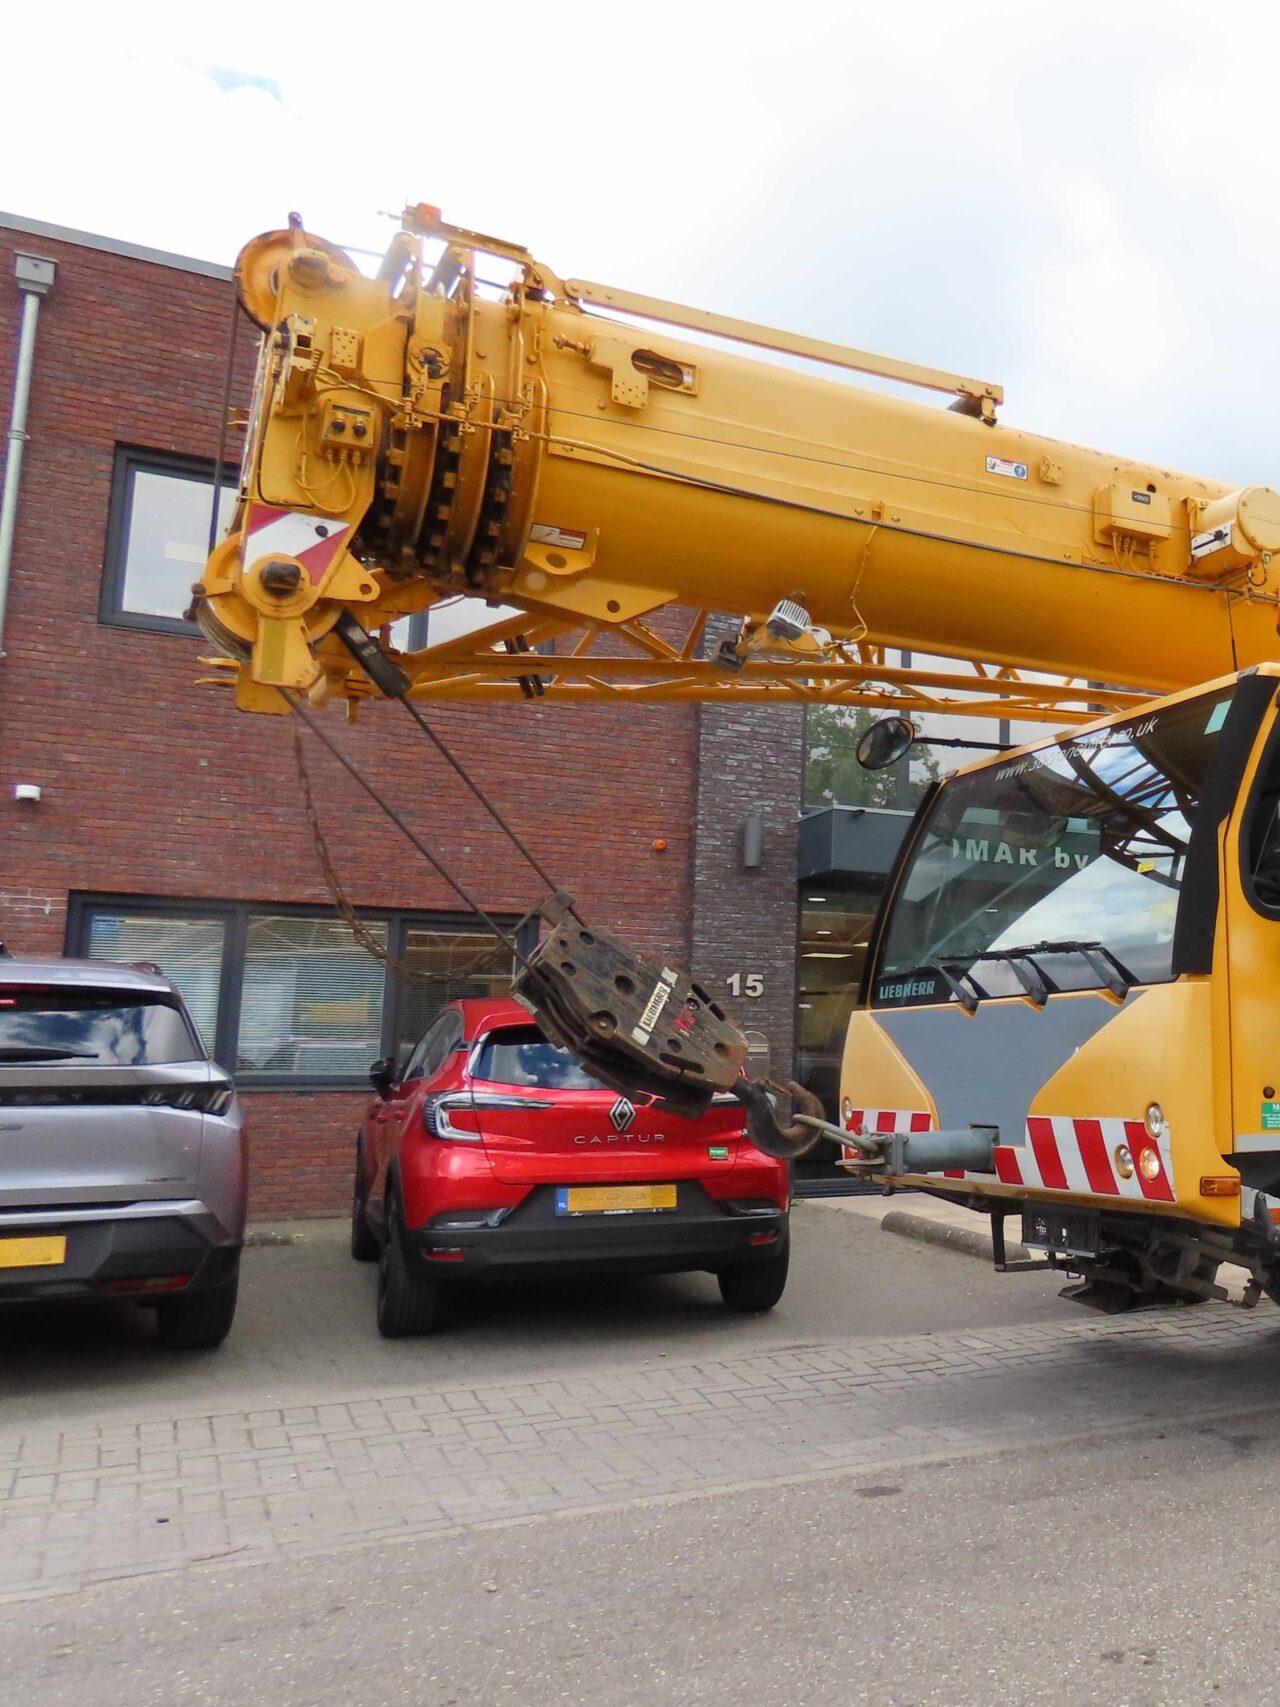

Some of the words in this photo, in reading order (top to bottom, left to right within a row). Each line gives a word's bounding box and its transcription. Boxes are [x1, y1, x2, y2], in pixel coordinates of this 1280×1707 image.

[1054, 846, 1089, 870] bv
[726, 973, 764, 997] 15
[879, 980, 935, 999] LIEBHERR
[574, 1134, 666, 1144] CAPTUR
